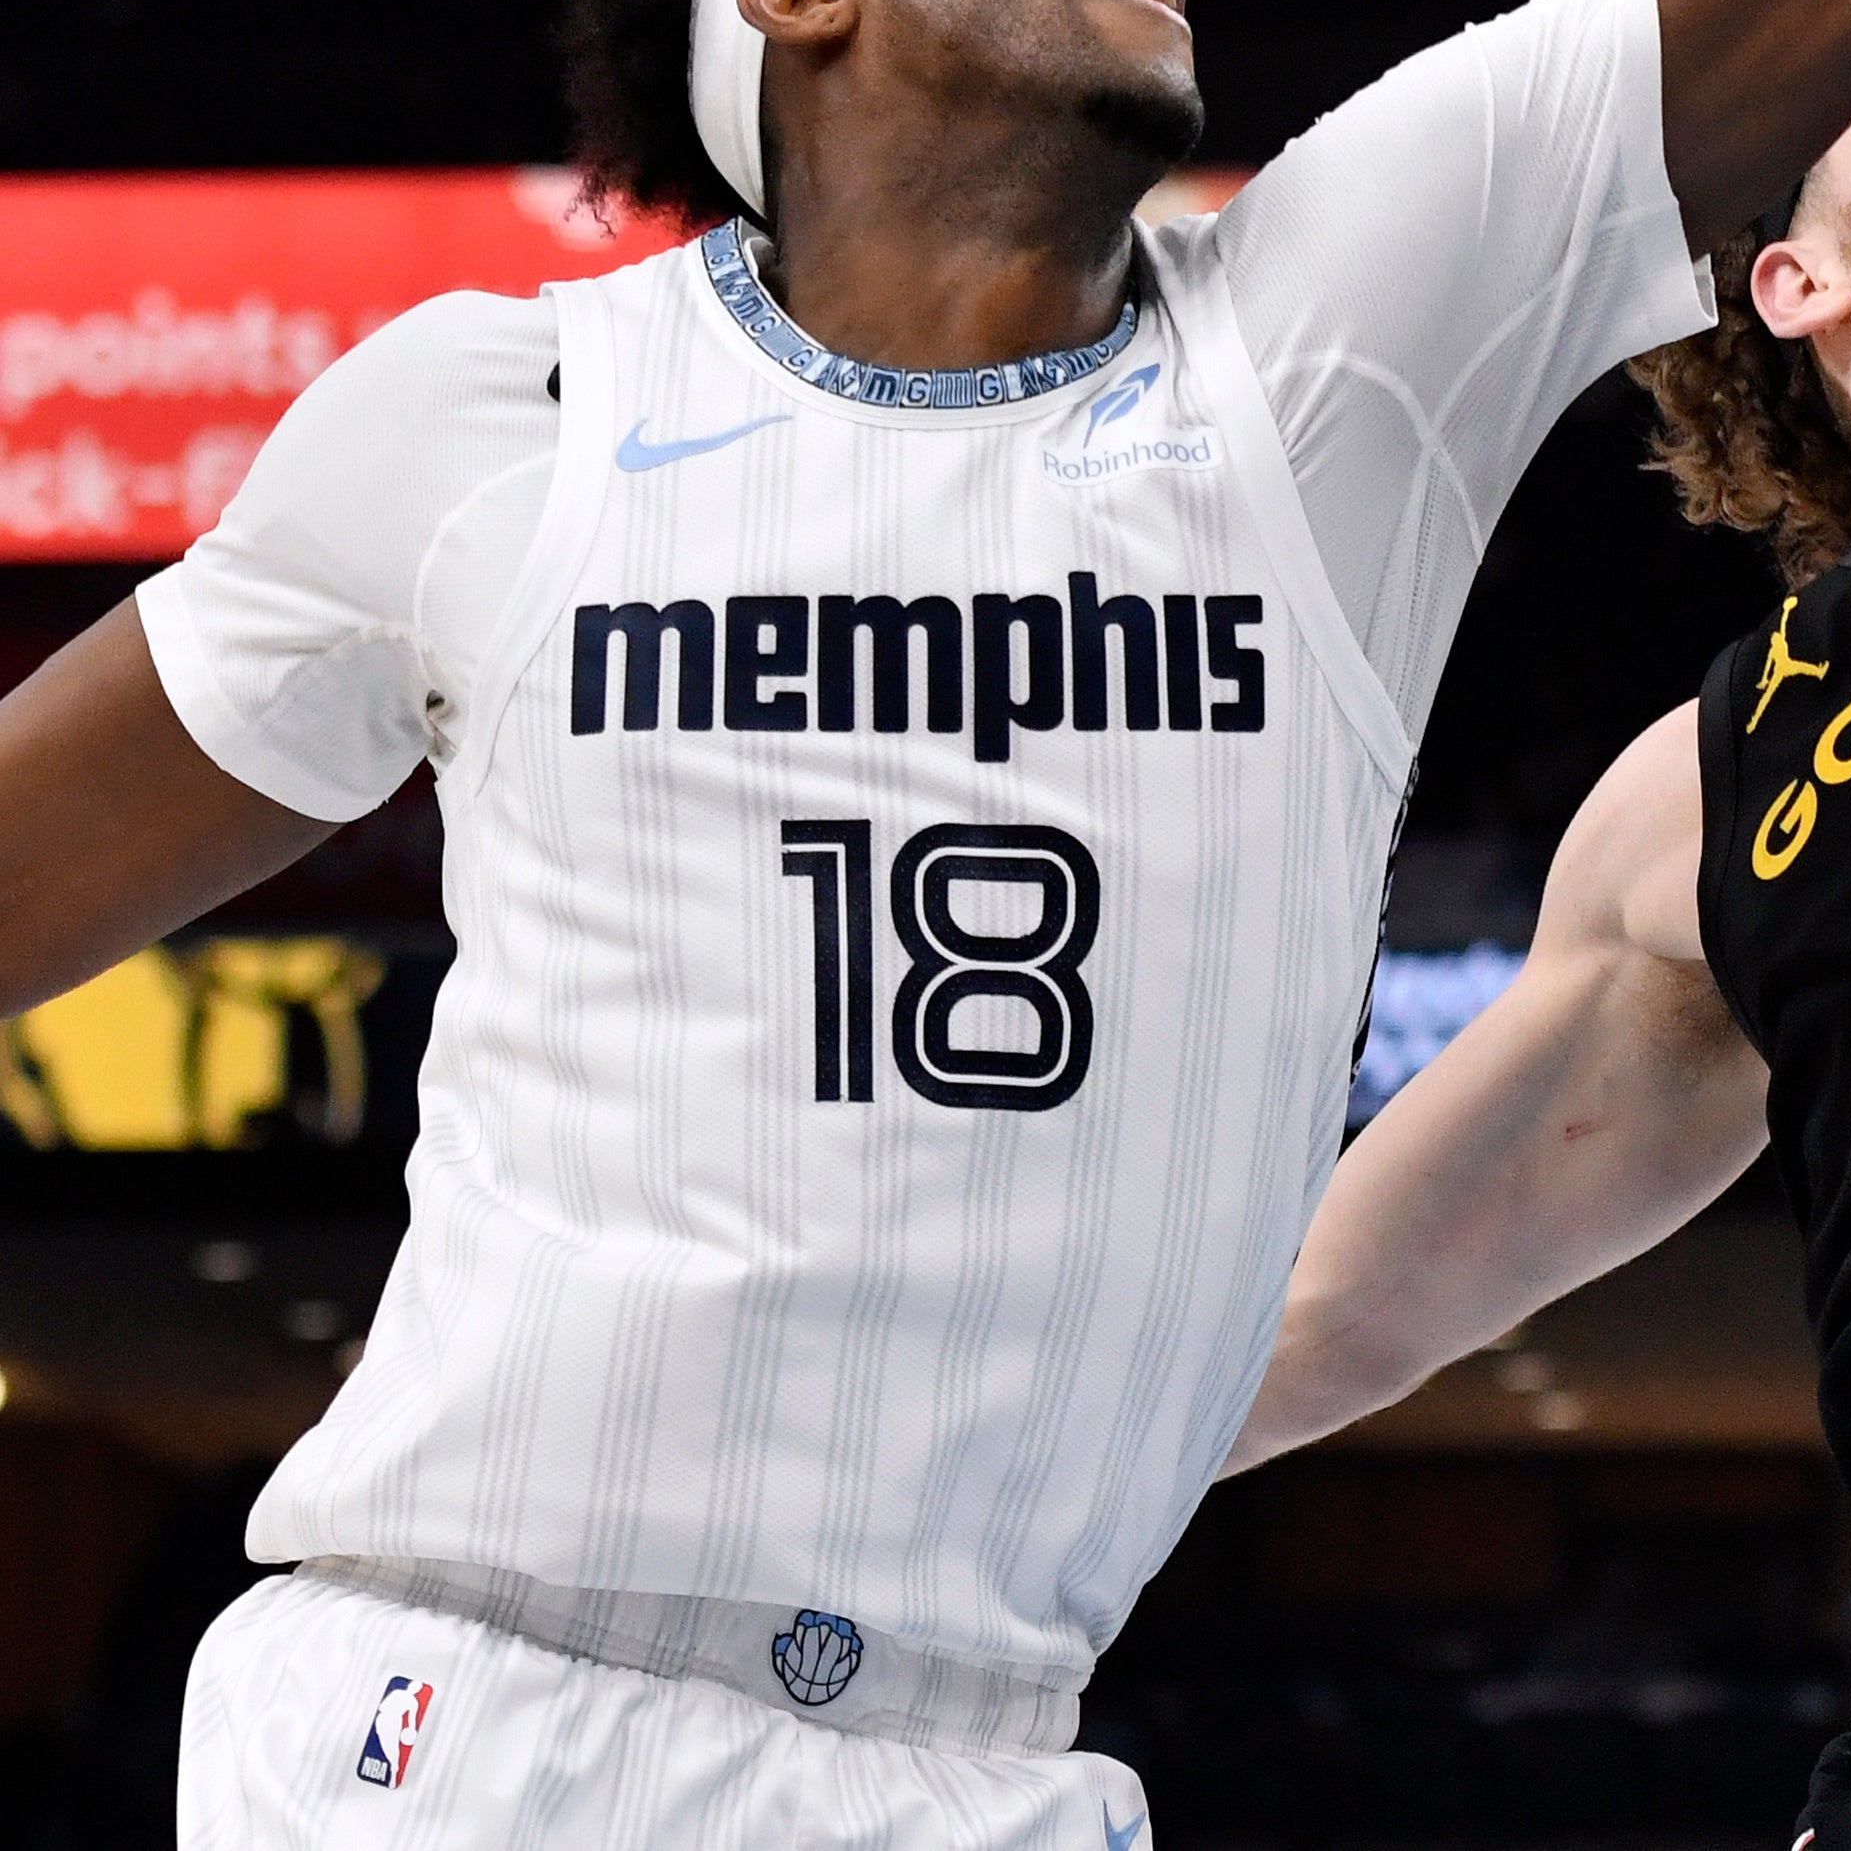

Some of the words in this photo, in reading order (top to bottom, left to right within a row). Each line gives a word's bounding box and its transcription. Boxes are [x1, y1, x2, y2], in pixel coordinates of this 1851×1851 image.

[1043, 436, 1212, 480] Robinhood
[571, 571, 1265, 763] memphis
[780, 819, 1101, 1112] 18
[360, 1755, 389, 1783] NBA
